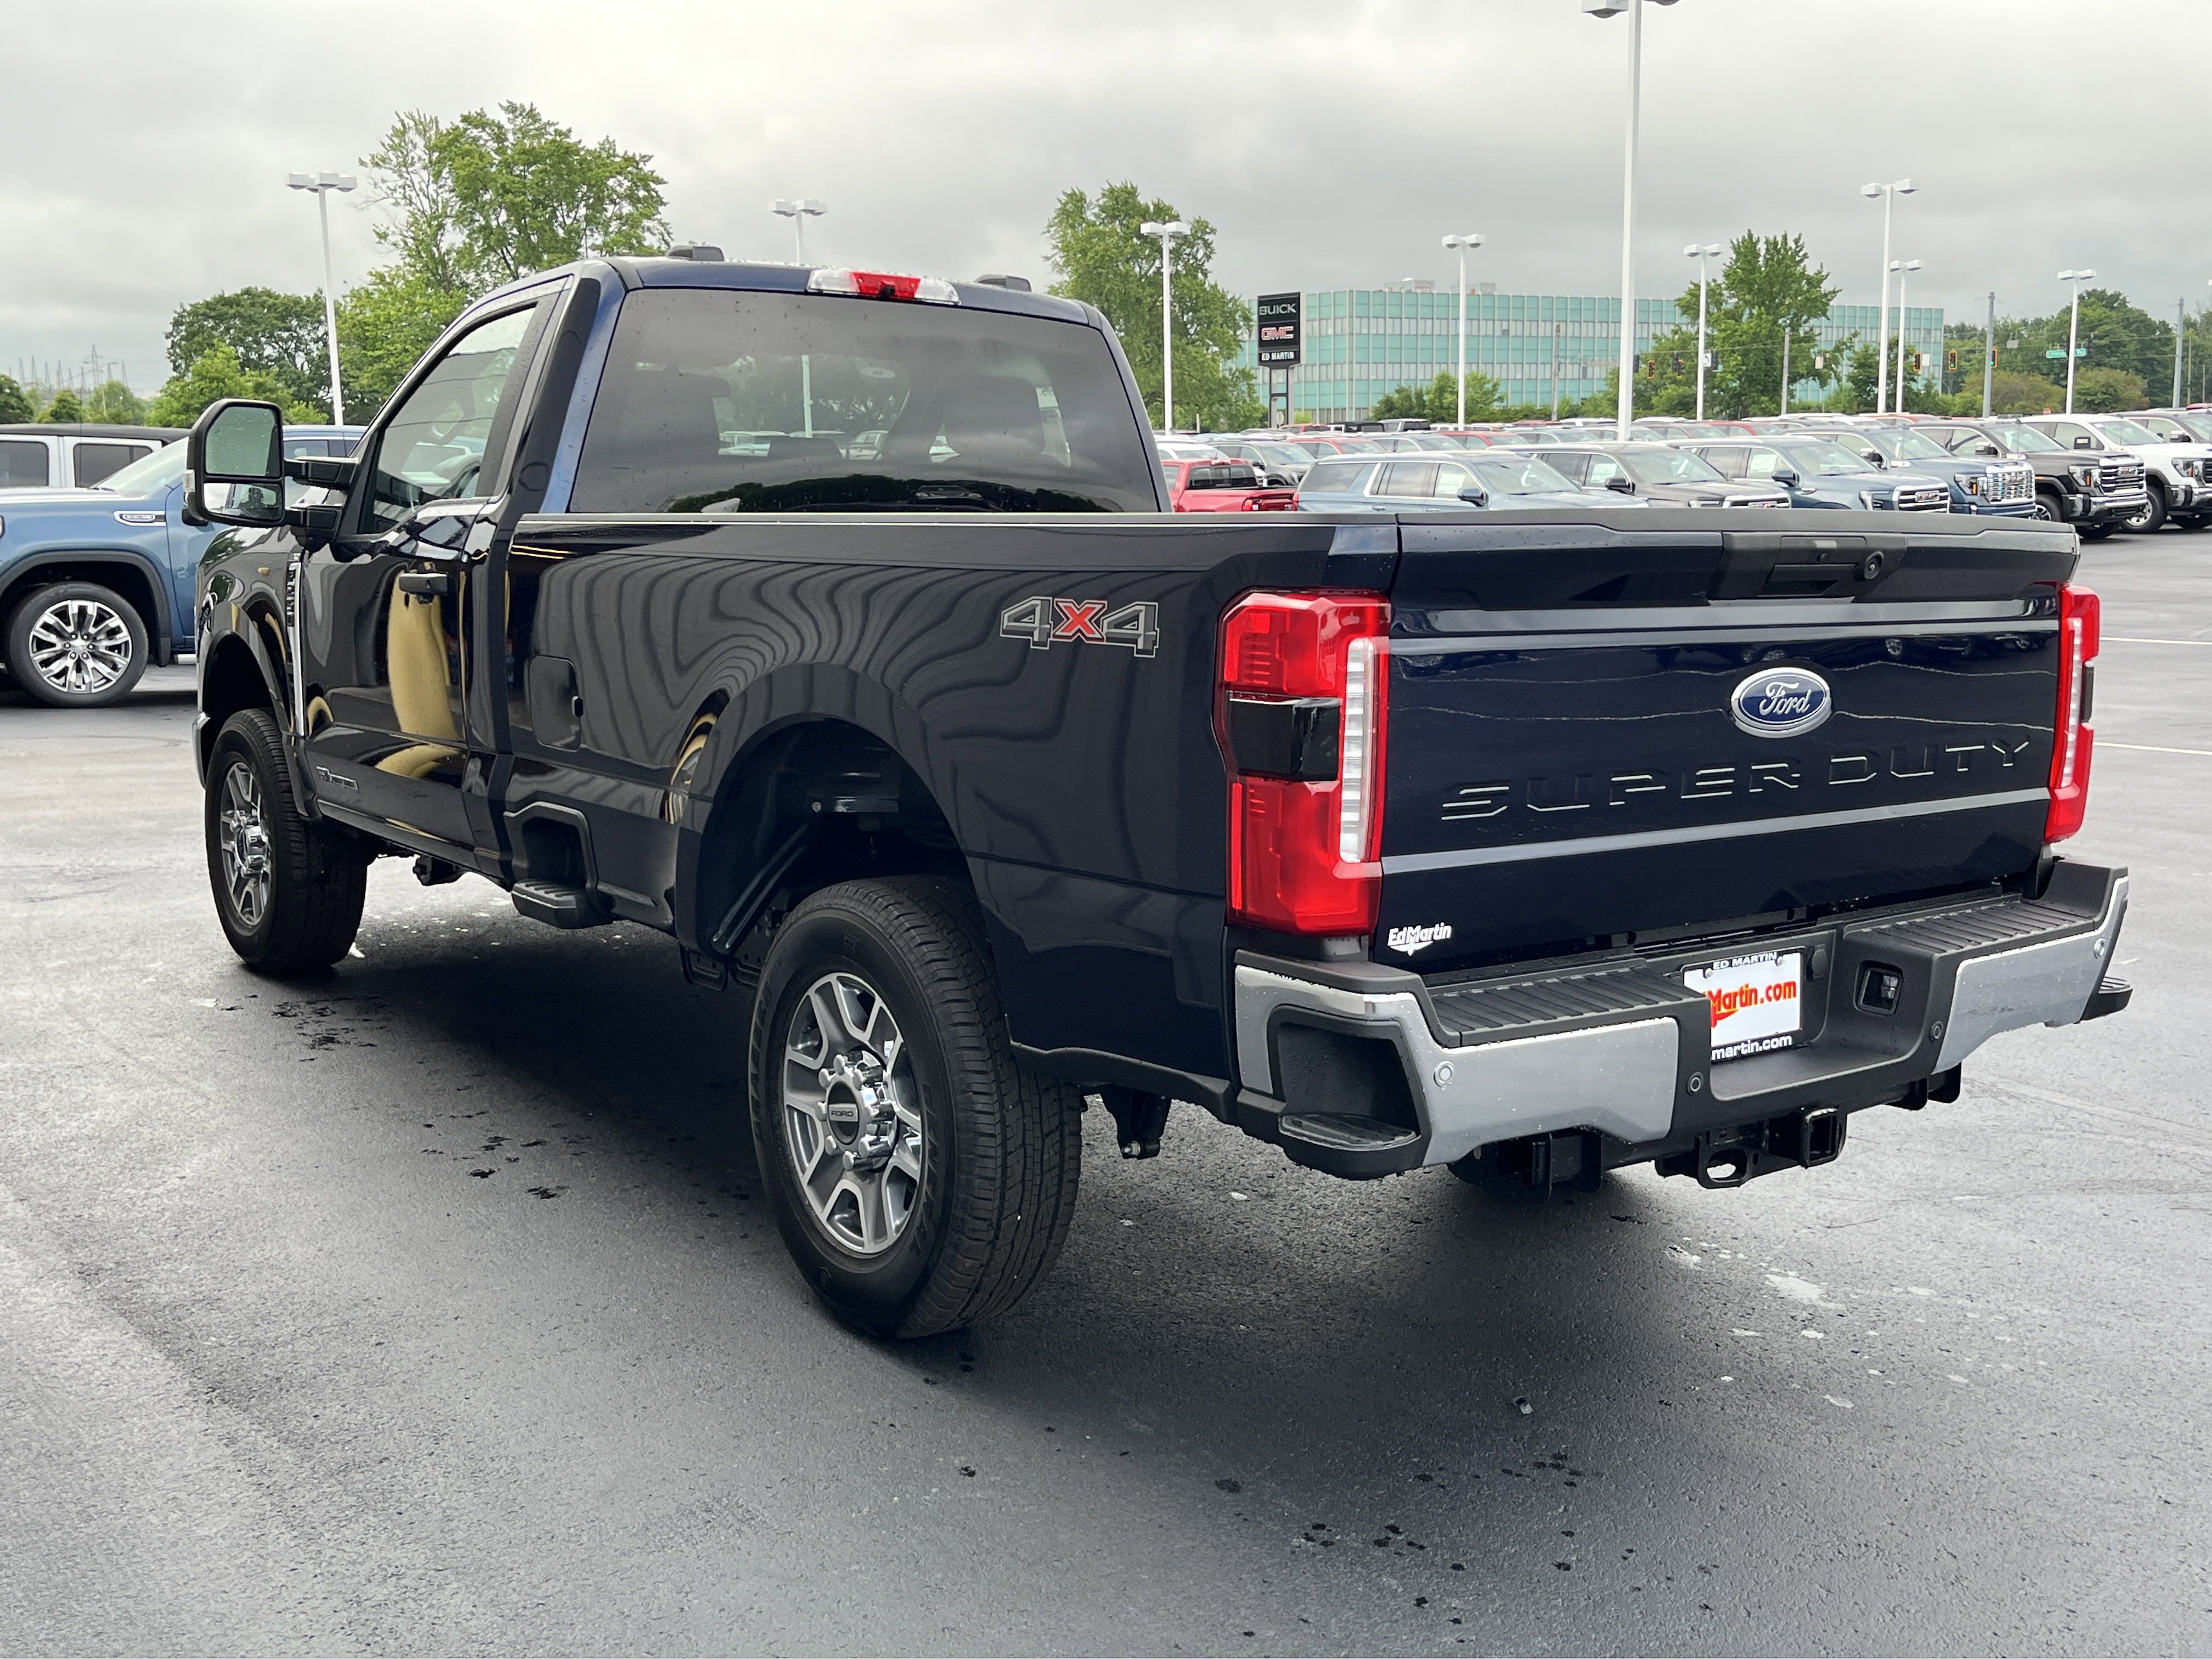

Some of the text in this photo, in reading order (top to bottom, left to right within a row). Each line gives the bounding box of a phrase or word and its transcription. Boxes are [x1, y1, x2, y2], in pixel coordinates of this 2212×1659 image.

[1259, 303, 1296, 315] BUICK
[1261, 326, 1294, 340] GMC
[1262, 351, 1294, 361] ED MARTIN
[1759, 681, 1812, 715] Ford
[1441, 736, 2029, 820] SUPER DUTY
[1713, 952, 1778, 969] ED MARTIN
[1704, 980, 1797, 1012] Martin.com
[1711, 1035, 1792, 1061] martin.com
